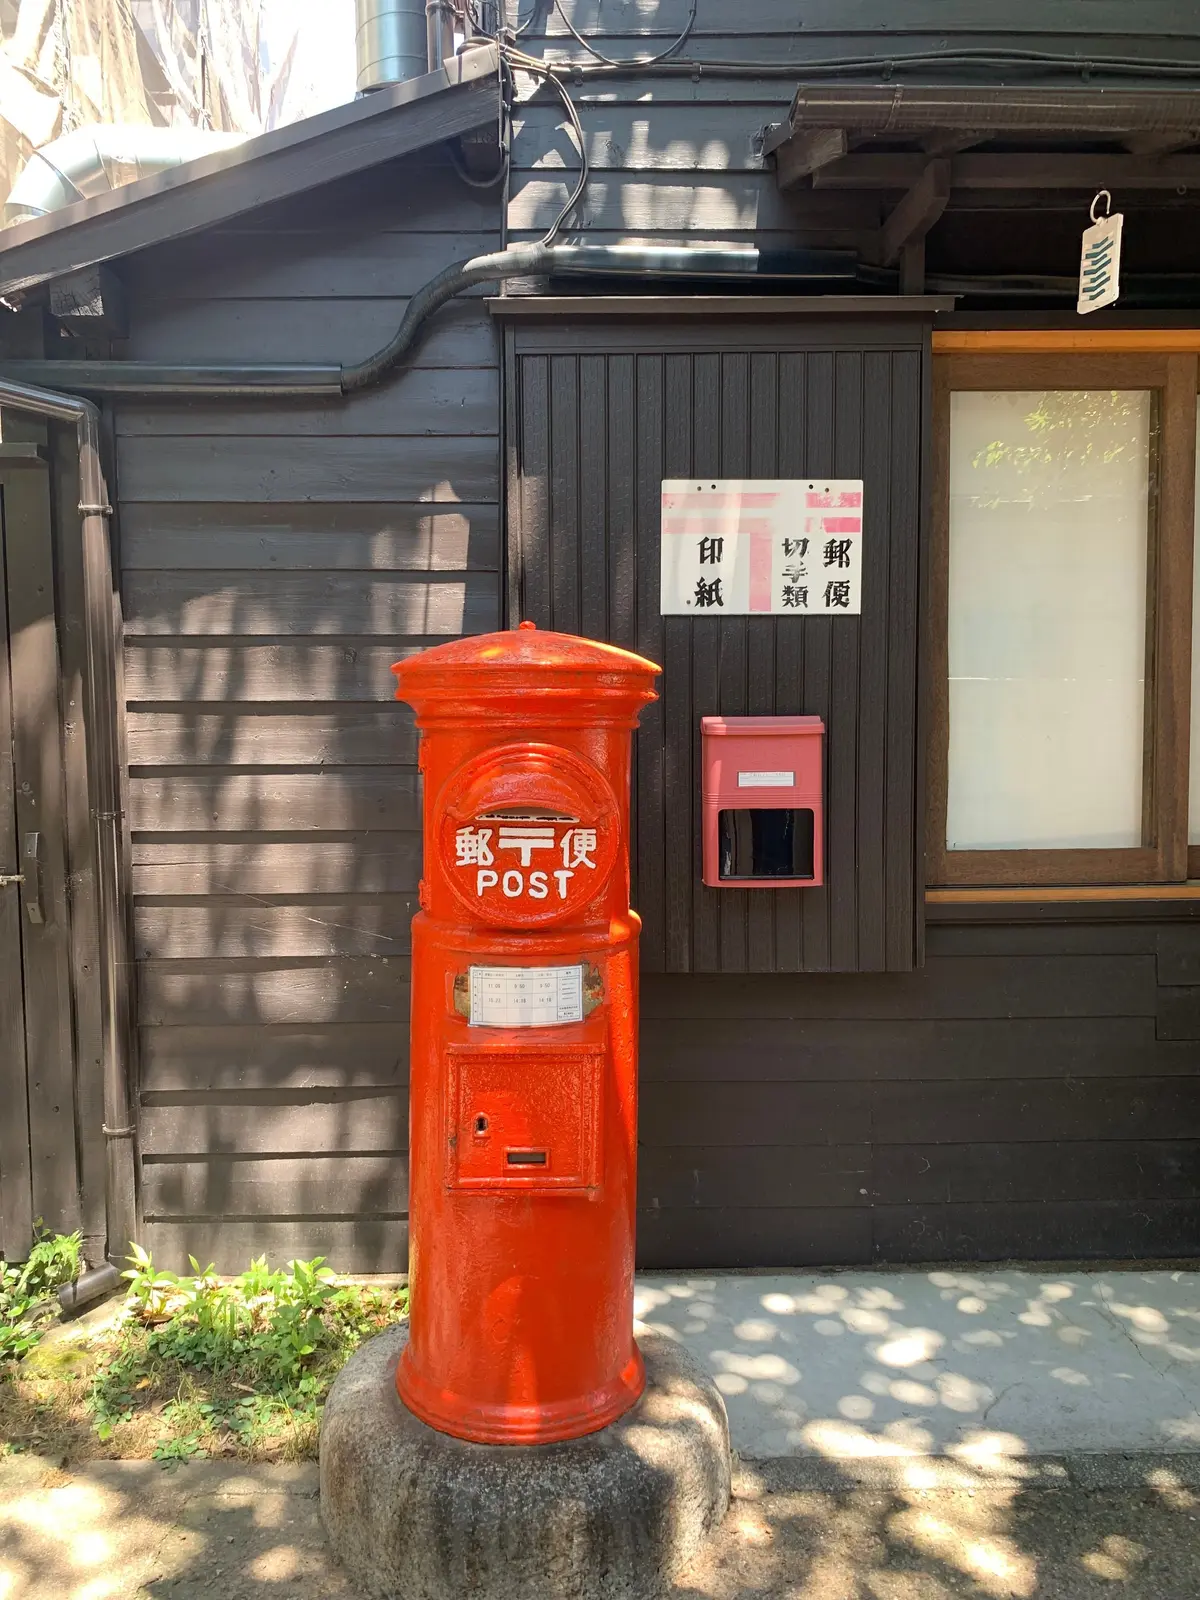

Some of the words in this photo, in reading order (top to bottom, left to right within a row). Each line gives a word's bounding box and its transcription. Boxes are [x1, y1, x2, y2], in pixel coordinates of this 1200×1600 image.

[694, 536, 725, 608] 印紙
[781, 537, 810, 608] 切手類
[822, 537, 853, 608] 郵便
[476, 869, 575, 900] POST
